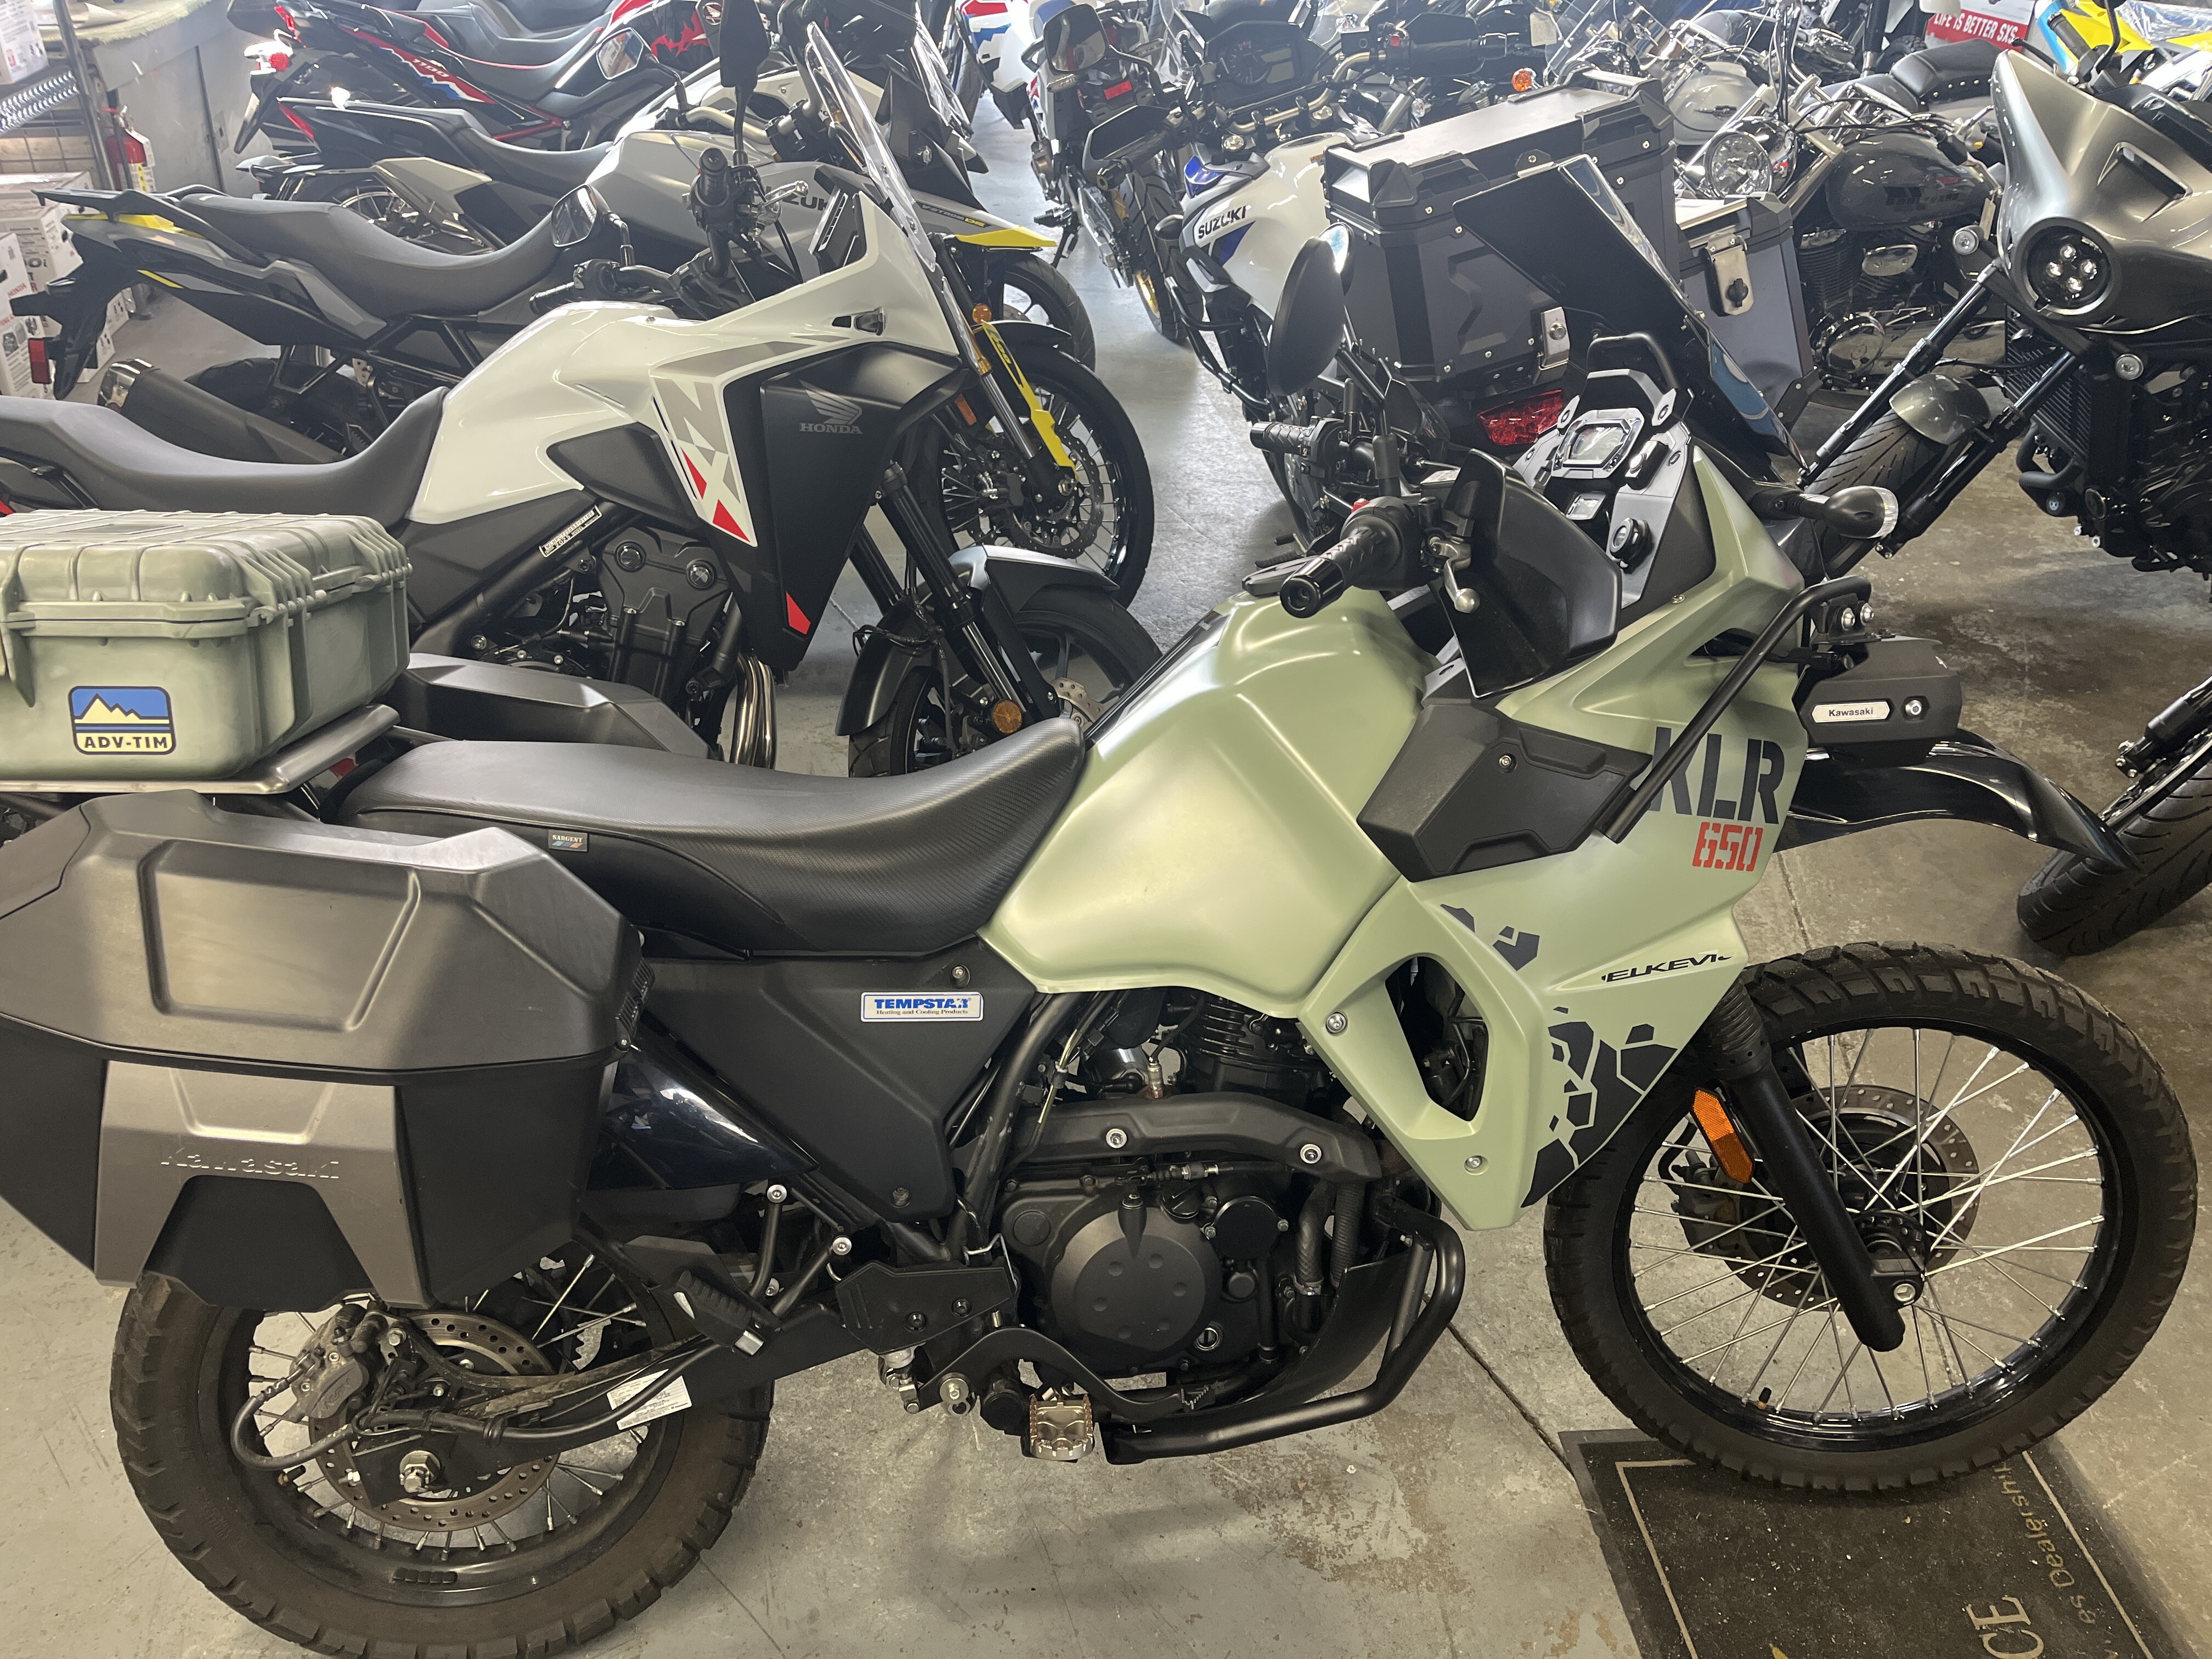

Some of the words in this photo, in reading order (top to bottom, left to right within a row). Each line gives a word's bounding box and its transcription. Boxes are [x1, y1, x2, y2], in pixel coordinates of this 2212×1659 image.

[1953, 13, 1965, 30] IS
[1962, 14, 1999, 40] BETTER
[1996, 23, 2019, 44] SXS
[412, 58, 449, 77] 1100
[1198, 206, 1246, 239] SUZUKI
[799, 422, 863, 435] HONDA
[554, 534, 571, 548] 2025
[1829, 707, 1874, 717] Kawasaki
[84, 736, 168, 748] ADV-TIM
[1647, 726, 1785, 825] KLR
[552, 834, 583, 843] SARGENT
[1692, 821, 1764, 872] 650
[160, 1148, 339, 1179] Kawasaki
